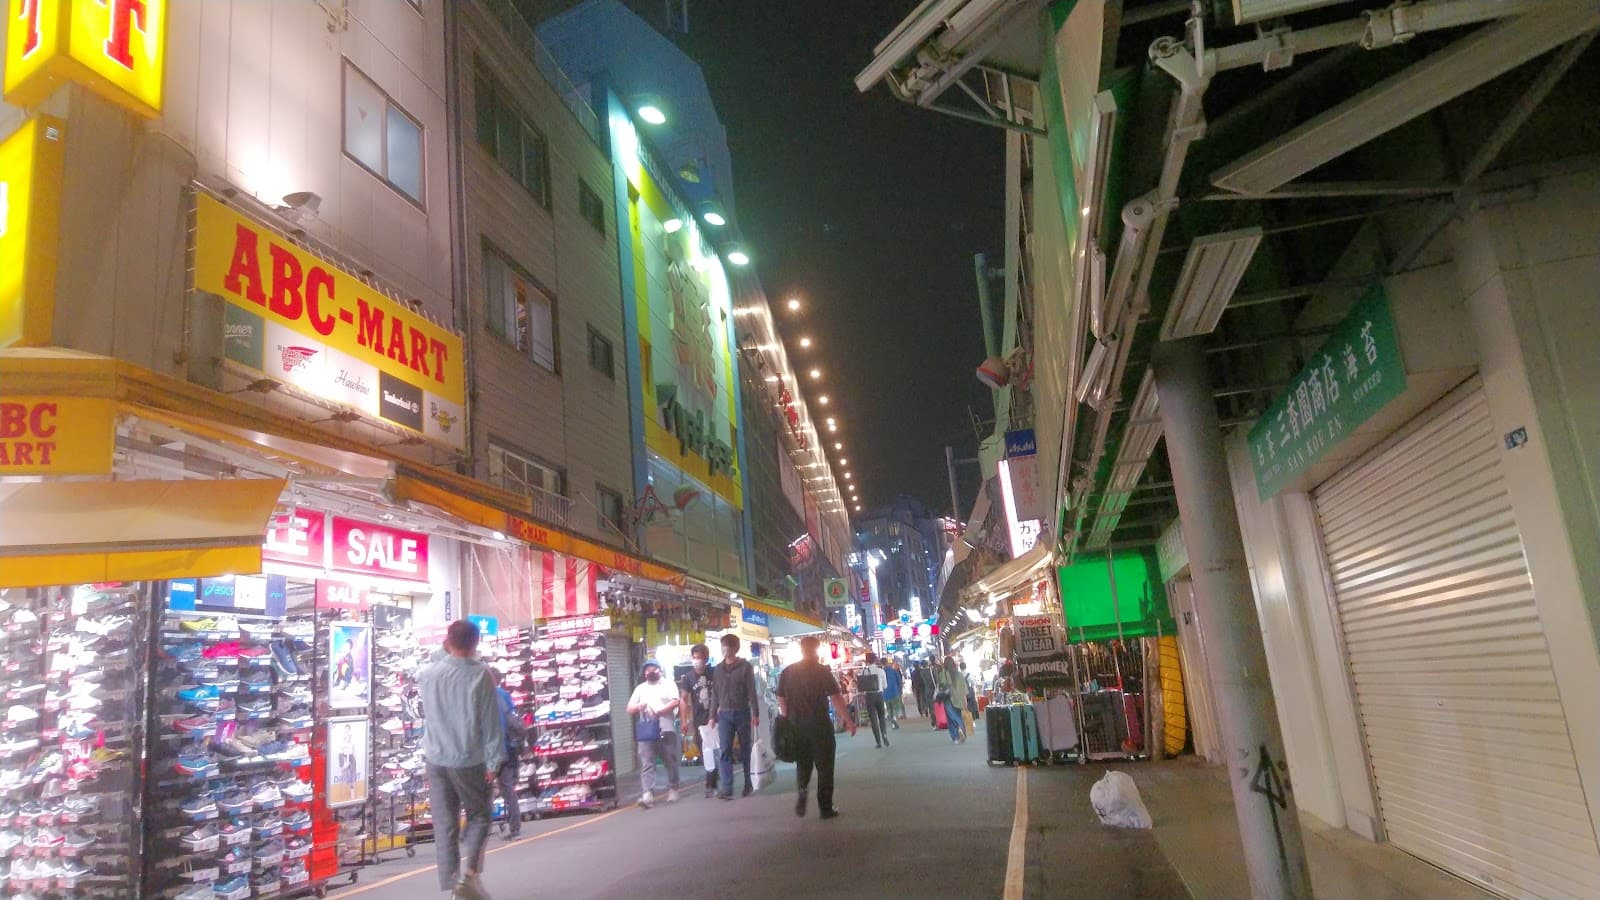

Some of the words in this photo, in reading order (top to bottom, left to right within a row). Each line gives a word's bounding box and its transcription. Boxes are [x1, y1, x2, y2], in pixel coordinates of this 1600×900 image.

[224, 223, 448, 384] ABC-MART
[347, 528, 418, 573] SALE
[327, 585, 361, 604] SALE
[1019, 617, 1051, 626] VISION
[1020, 626, 1052, 637] STREET
[1023, 638, 1052, 651] WEAR
[1020, 660, 1069, 679] THRASHER
